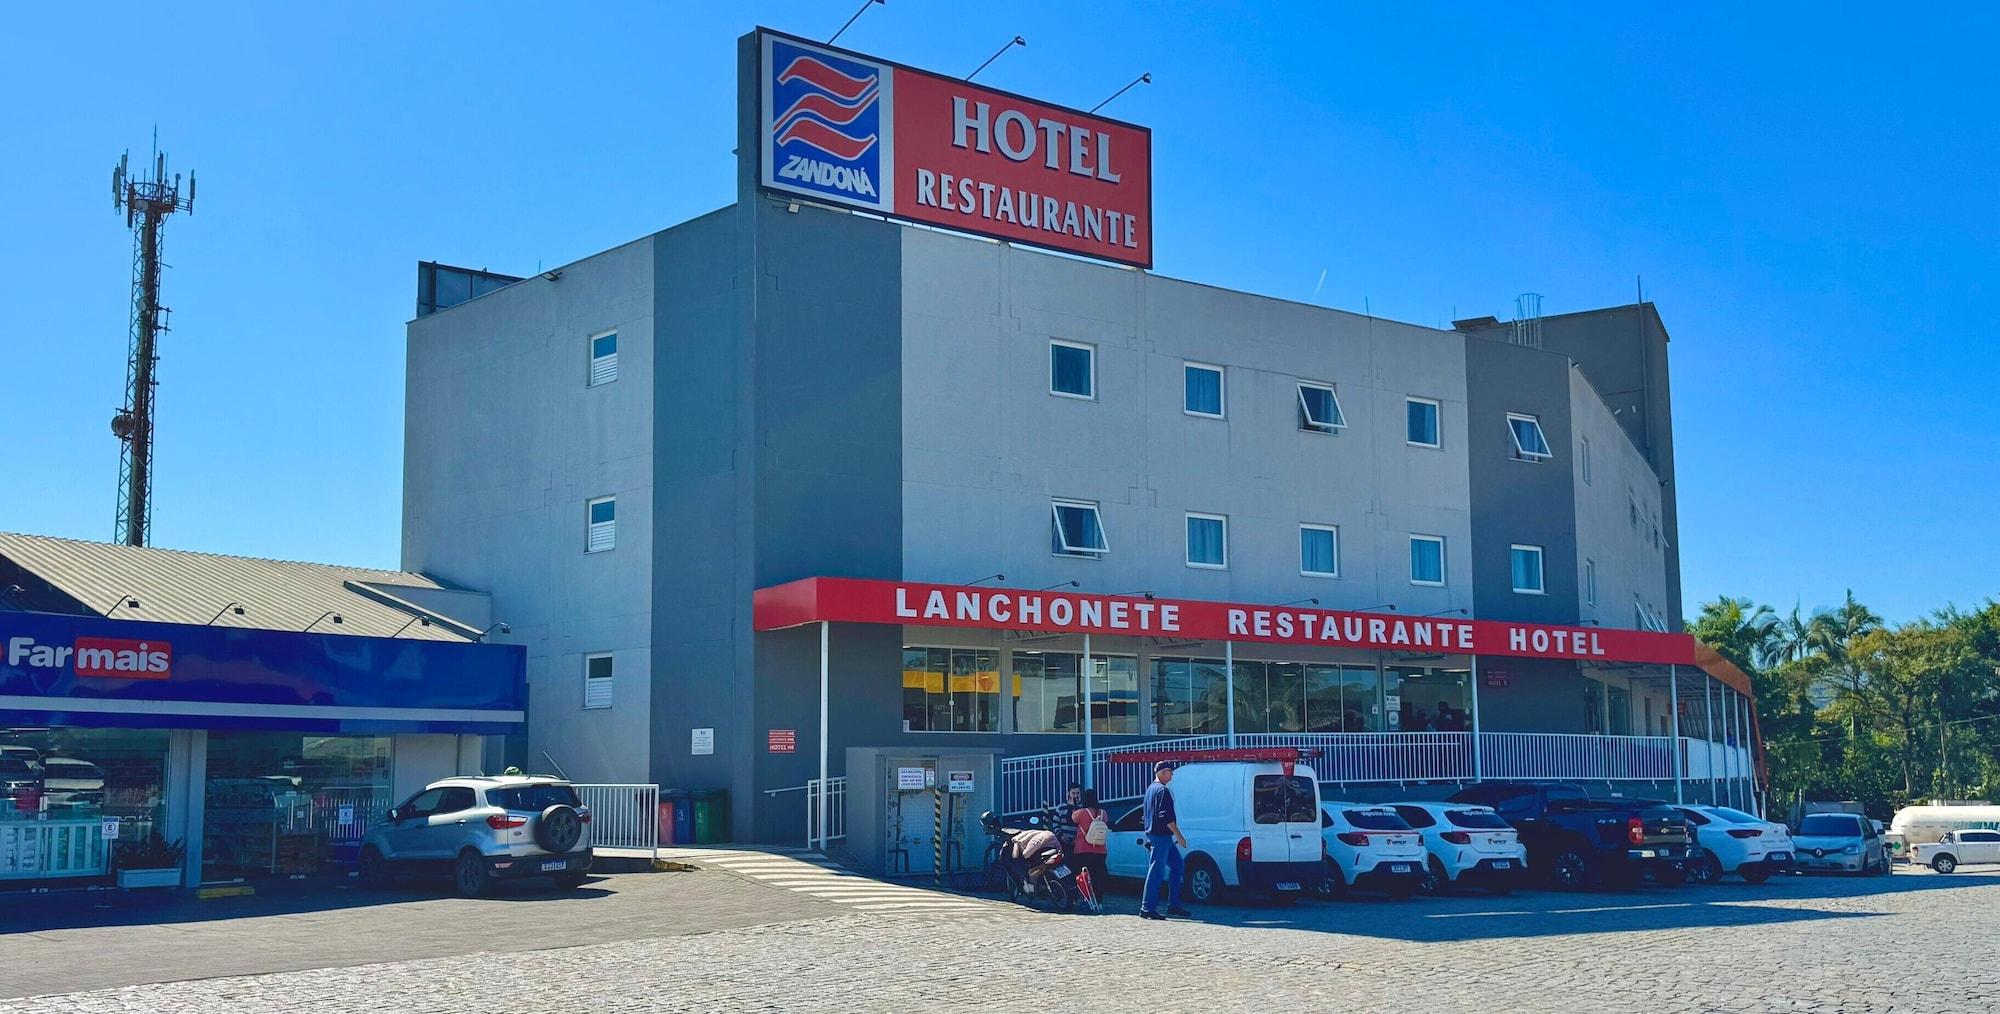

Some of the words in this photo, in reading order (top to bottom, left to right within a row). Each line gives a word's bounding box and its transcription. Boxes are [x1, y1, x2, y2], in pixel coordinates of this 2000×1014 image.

[778, 154, 877, 197] ZANDONÁ
[953, 96, 1121, 184] HOTEL
[917, 168, 1138, 248] RESTAURANTE
[896, 588, 1180, 632] LANCHONETE
[1228, 609, 1474, 649] RESTAURANTE
[1510, 628, 1605, 655] HOTEL
